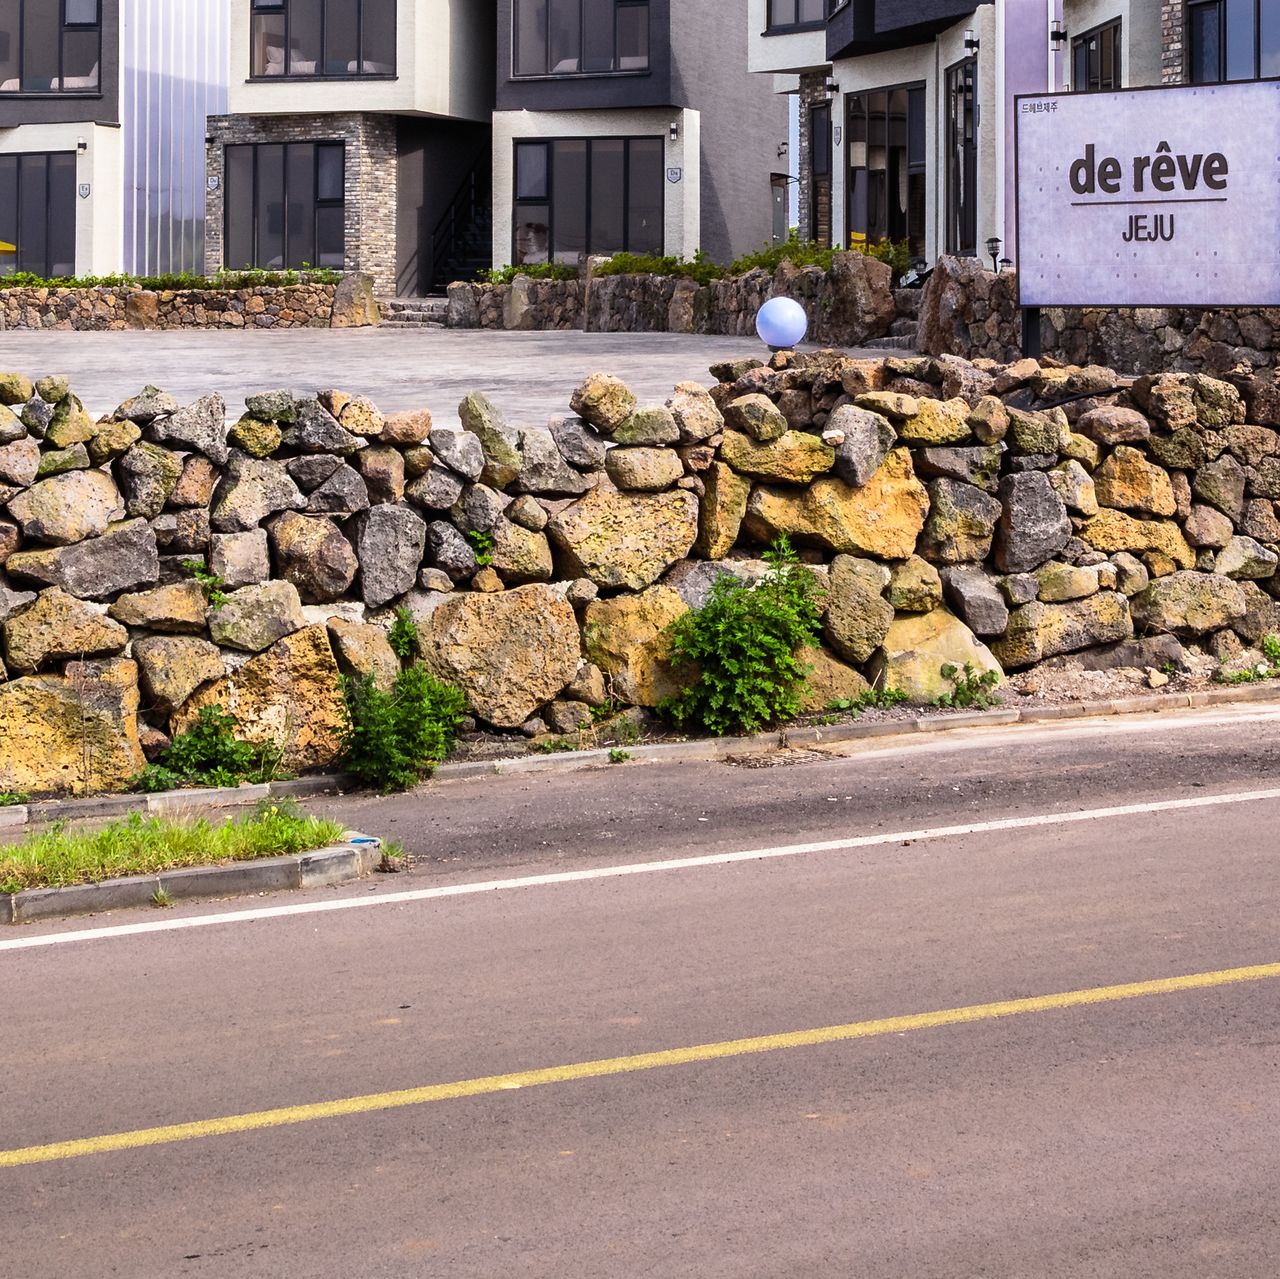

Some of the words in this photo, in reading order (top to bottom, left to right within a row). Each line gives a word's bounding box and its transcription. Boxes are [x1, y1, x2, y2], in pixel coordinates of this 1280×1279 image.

[1068, 143, 1122, 195] de
[1132, 140, 1229, 193] rêve
[1121, 213, 1175, 242] JEJU
